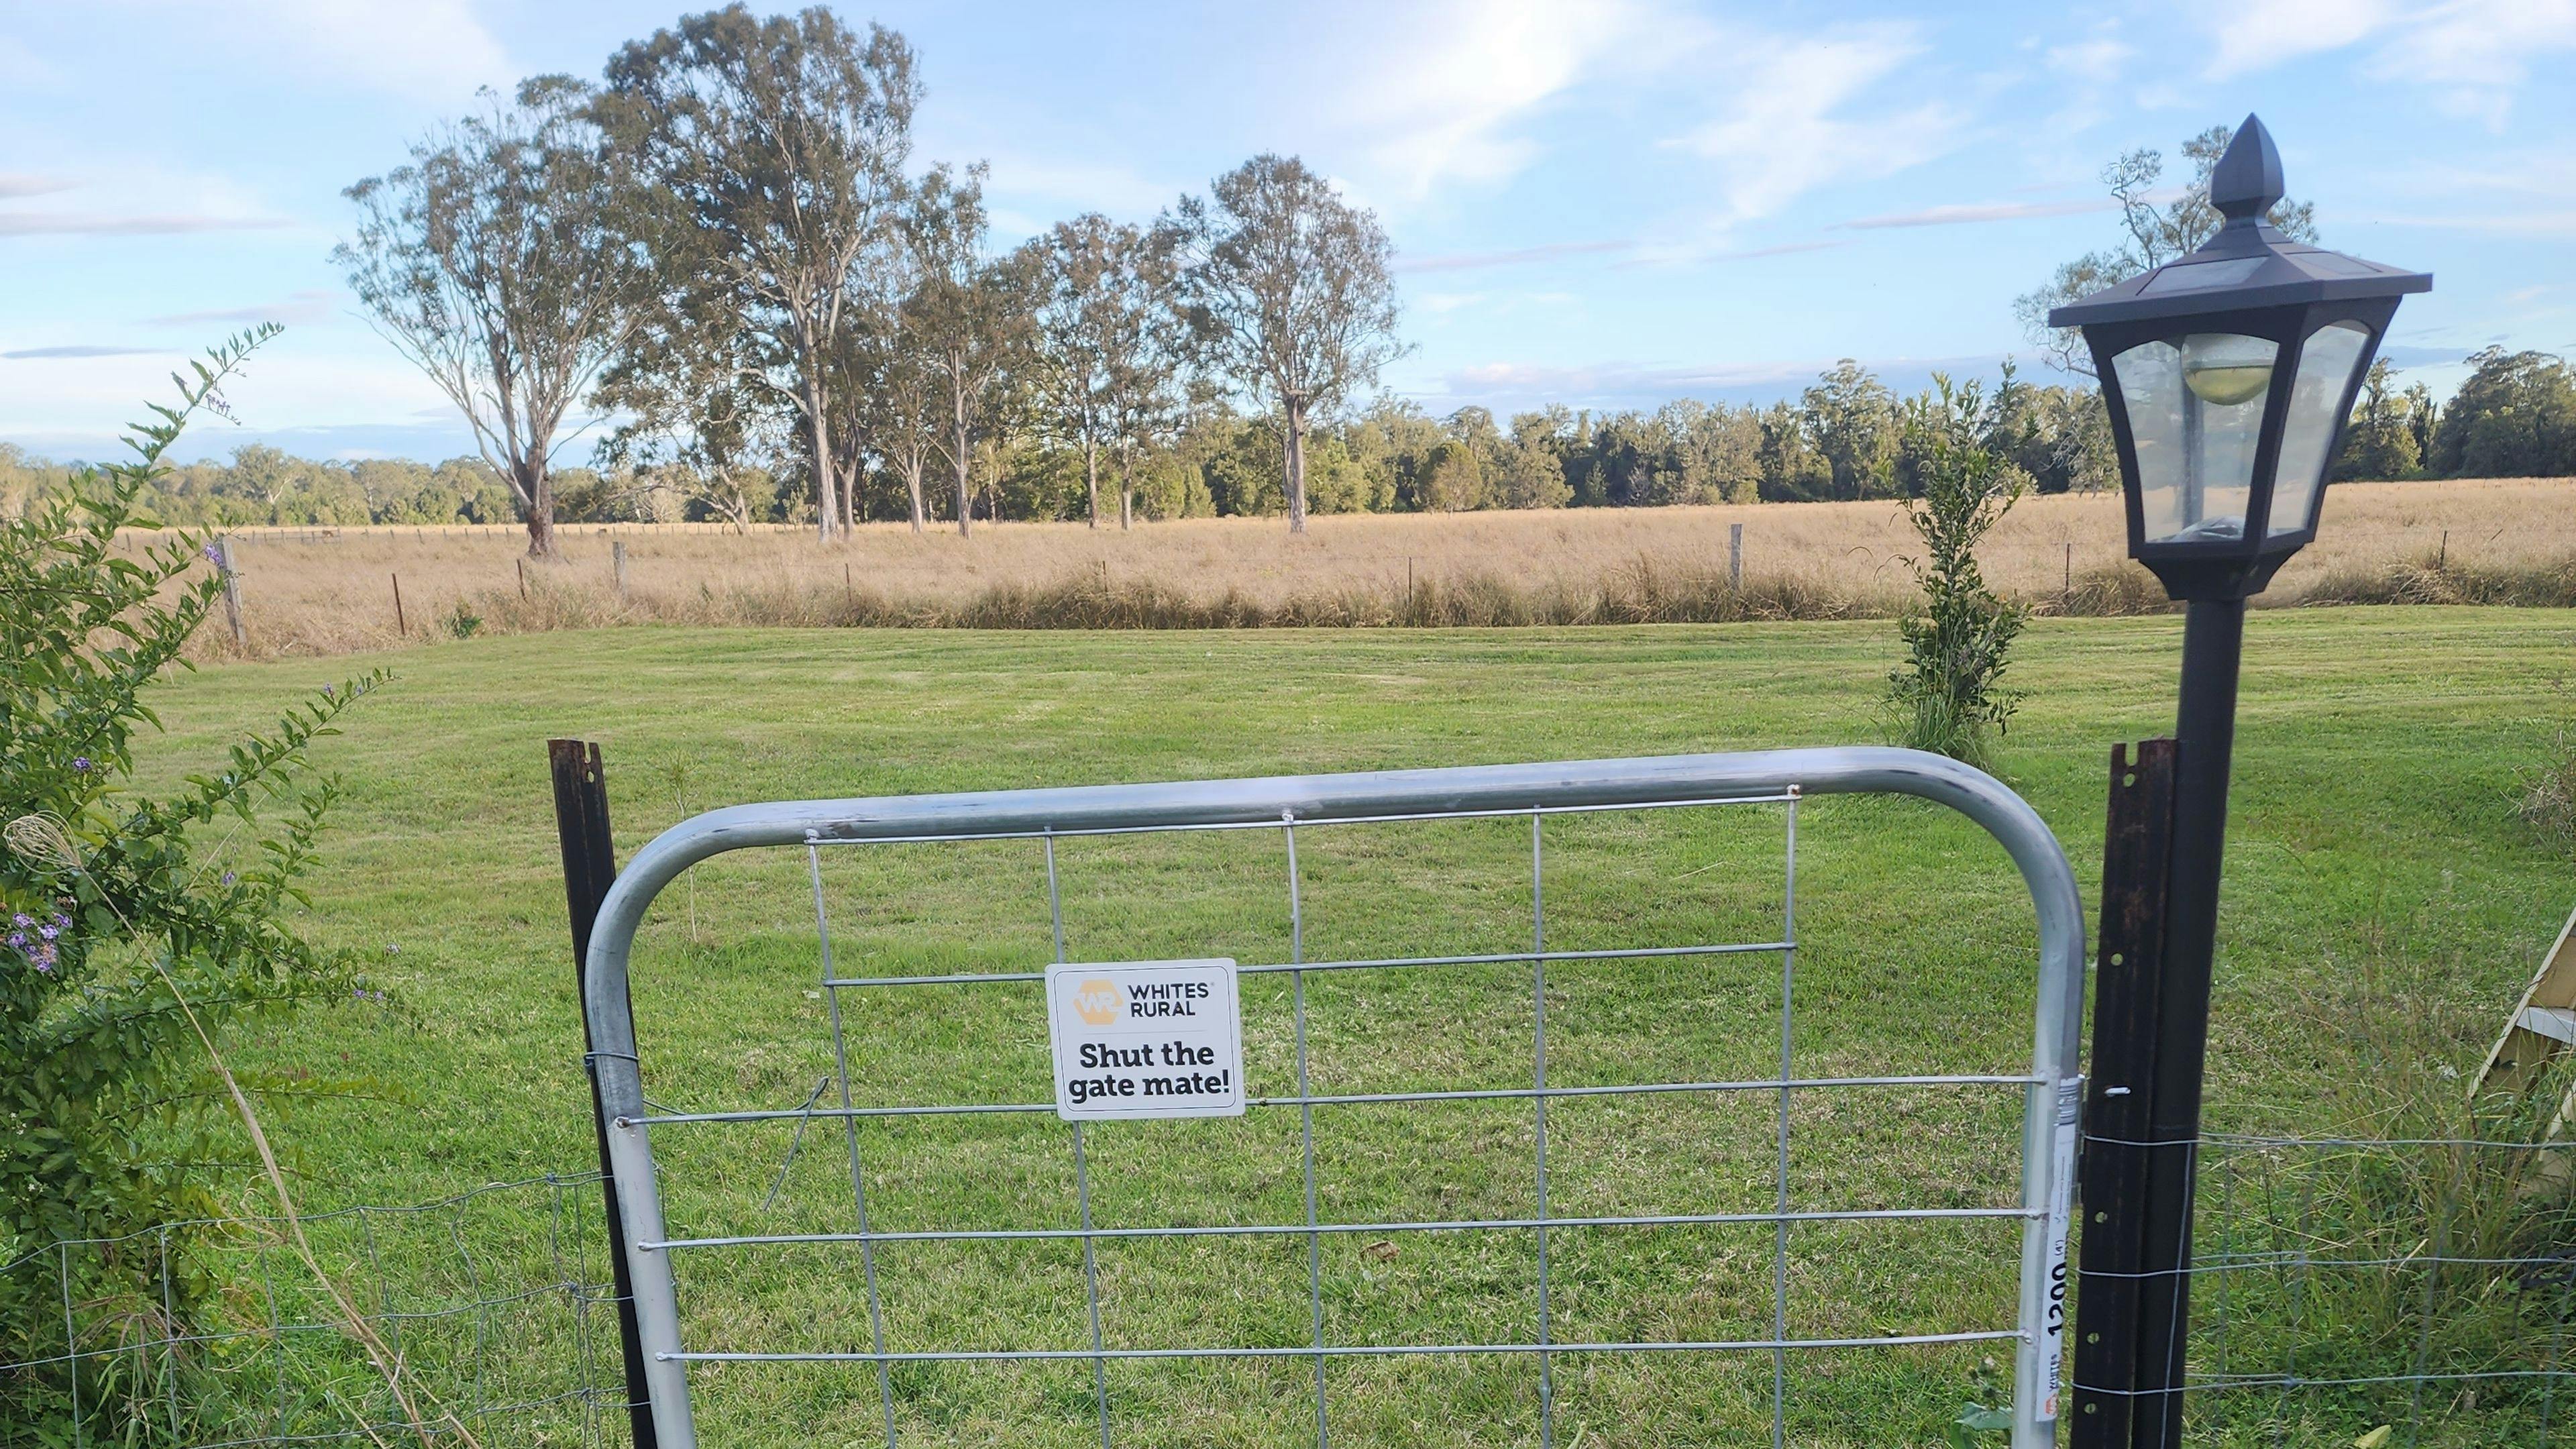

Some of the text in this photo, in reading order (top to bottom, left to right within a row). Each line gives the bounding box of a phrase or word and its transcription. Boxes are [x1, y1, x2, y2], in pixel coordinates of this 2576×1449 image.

[1128, 983, 1209, 1000] WHITES
[1131, 1001, 1196, 1017] RURAL
[1079, 1040, 1214, 1068] Shut the
[1069, 1069, 1230, 1104] gate mate!
